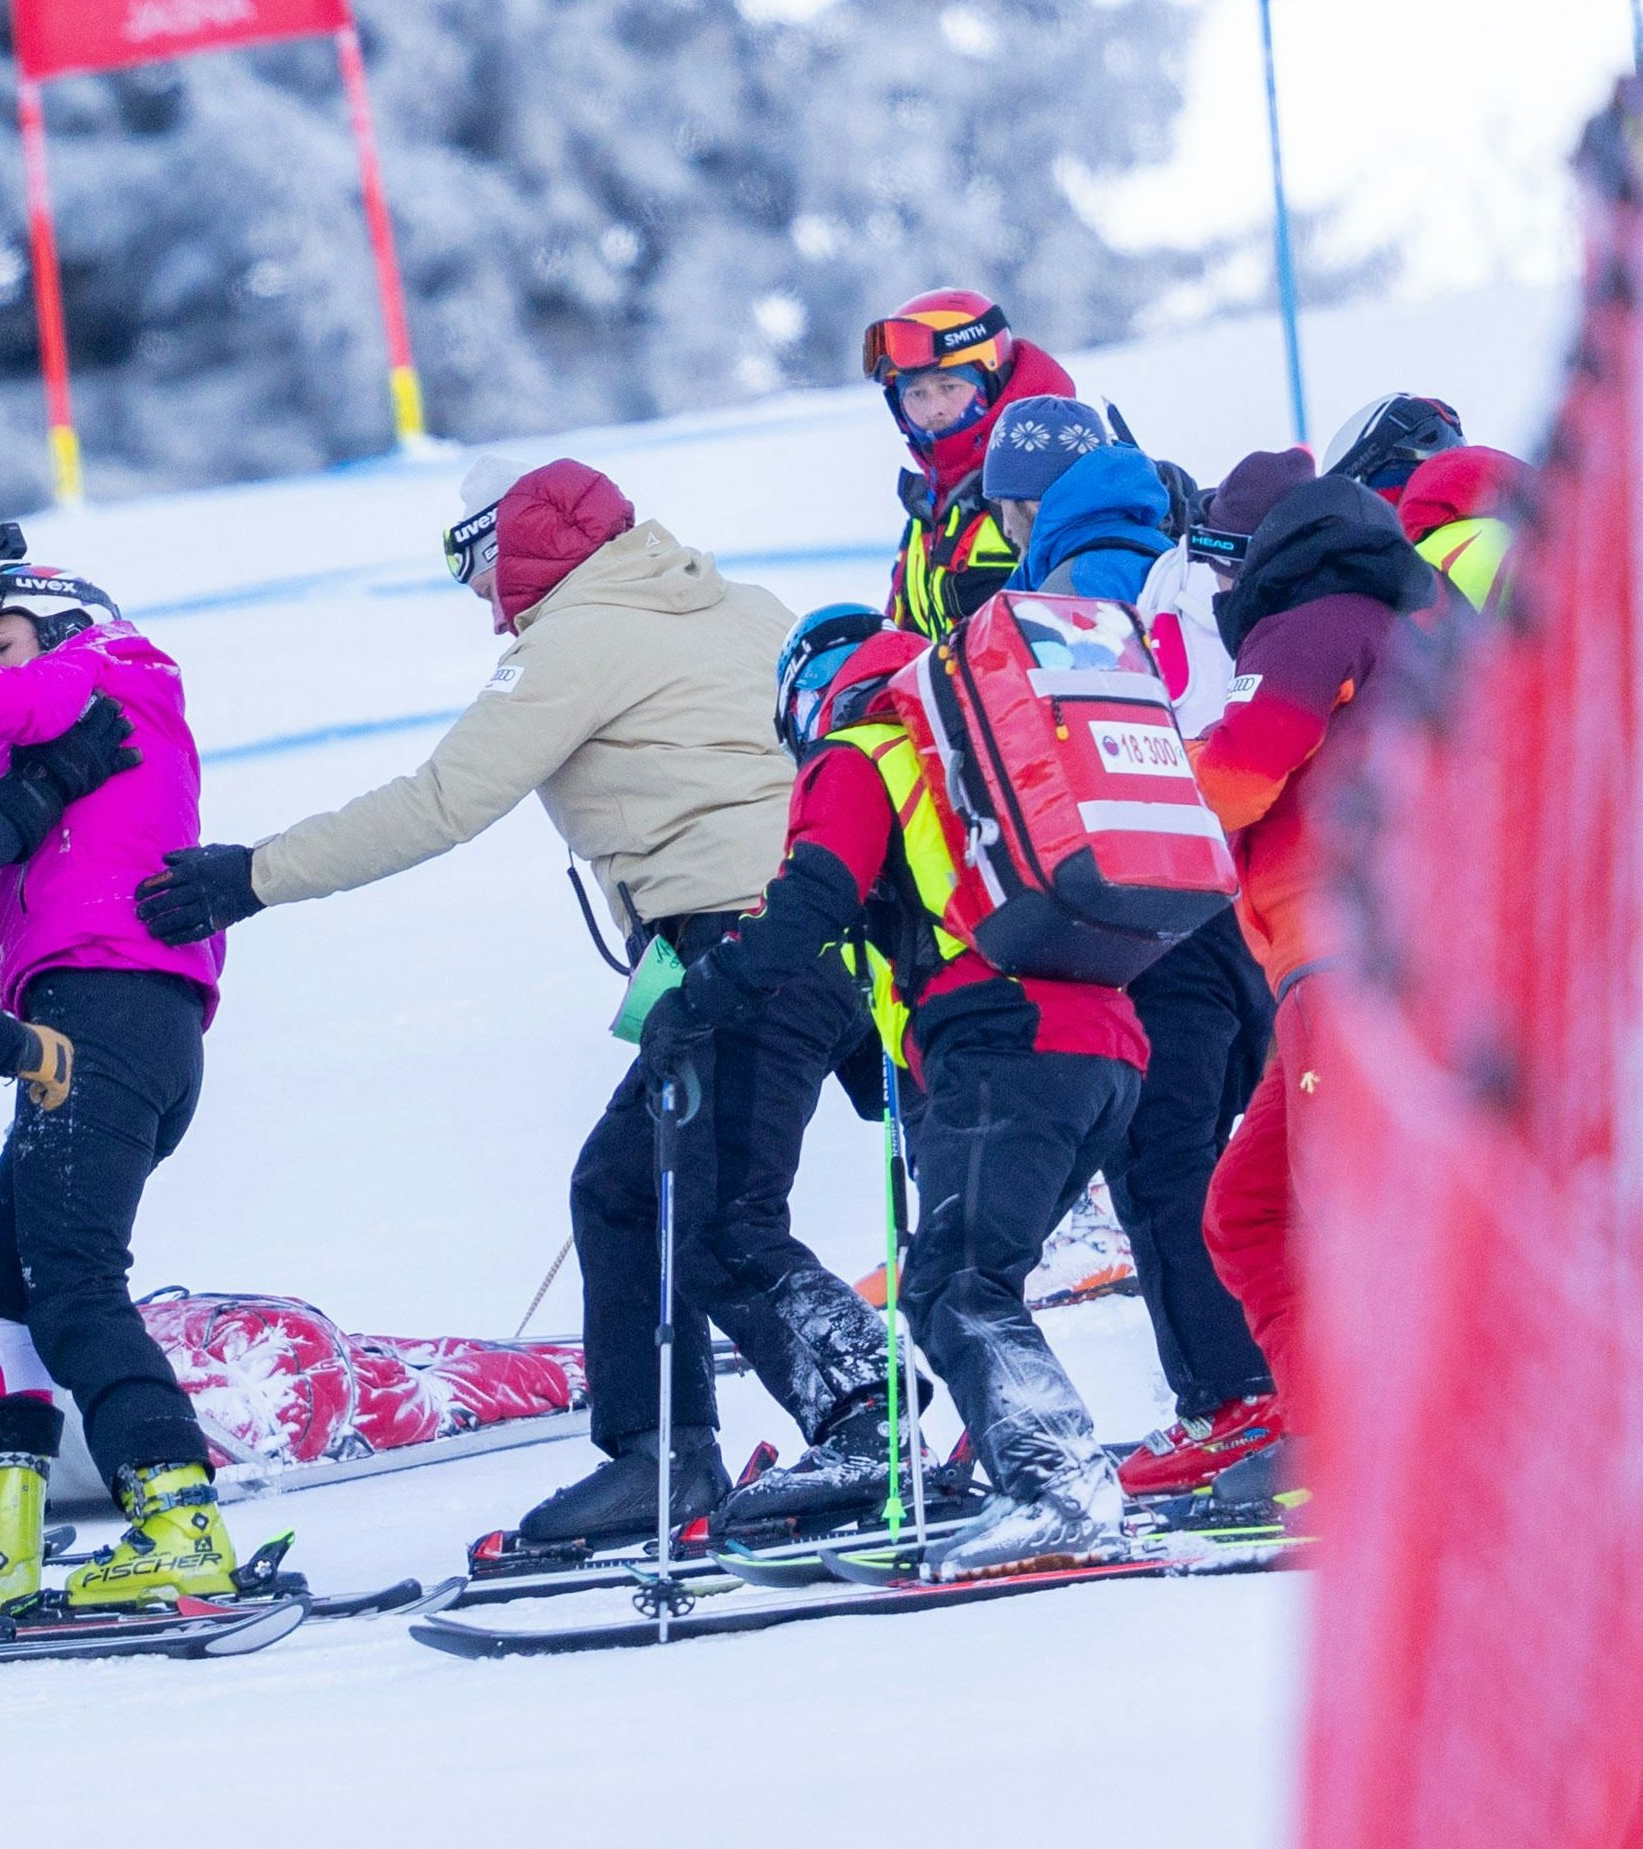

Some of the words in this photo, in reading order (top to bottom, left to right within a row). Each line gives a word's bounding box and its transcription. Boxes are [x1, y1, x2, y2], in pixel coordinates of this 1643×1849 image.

[944, 323, 987, 347] SMITH
[1191, 535, 1235, 551] HEAD
[15, 577, 77, 593] uvex
[1121, 733, 1144, 763] 18
[1143, 735, 1178, 767] 300
[82, 1552, 223, 1588] FISCHER
